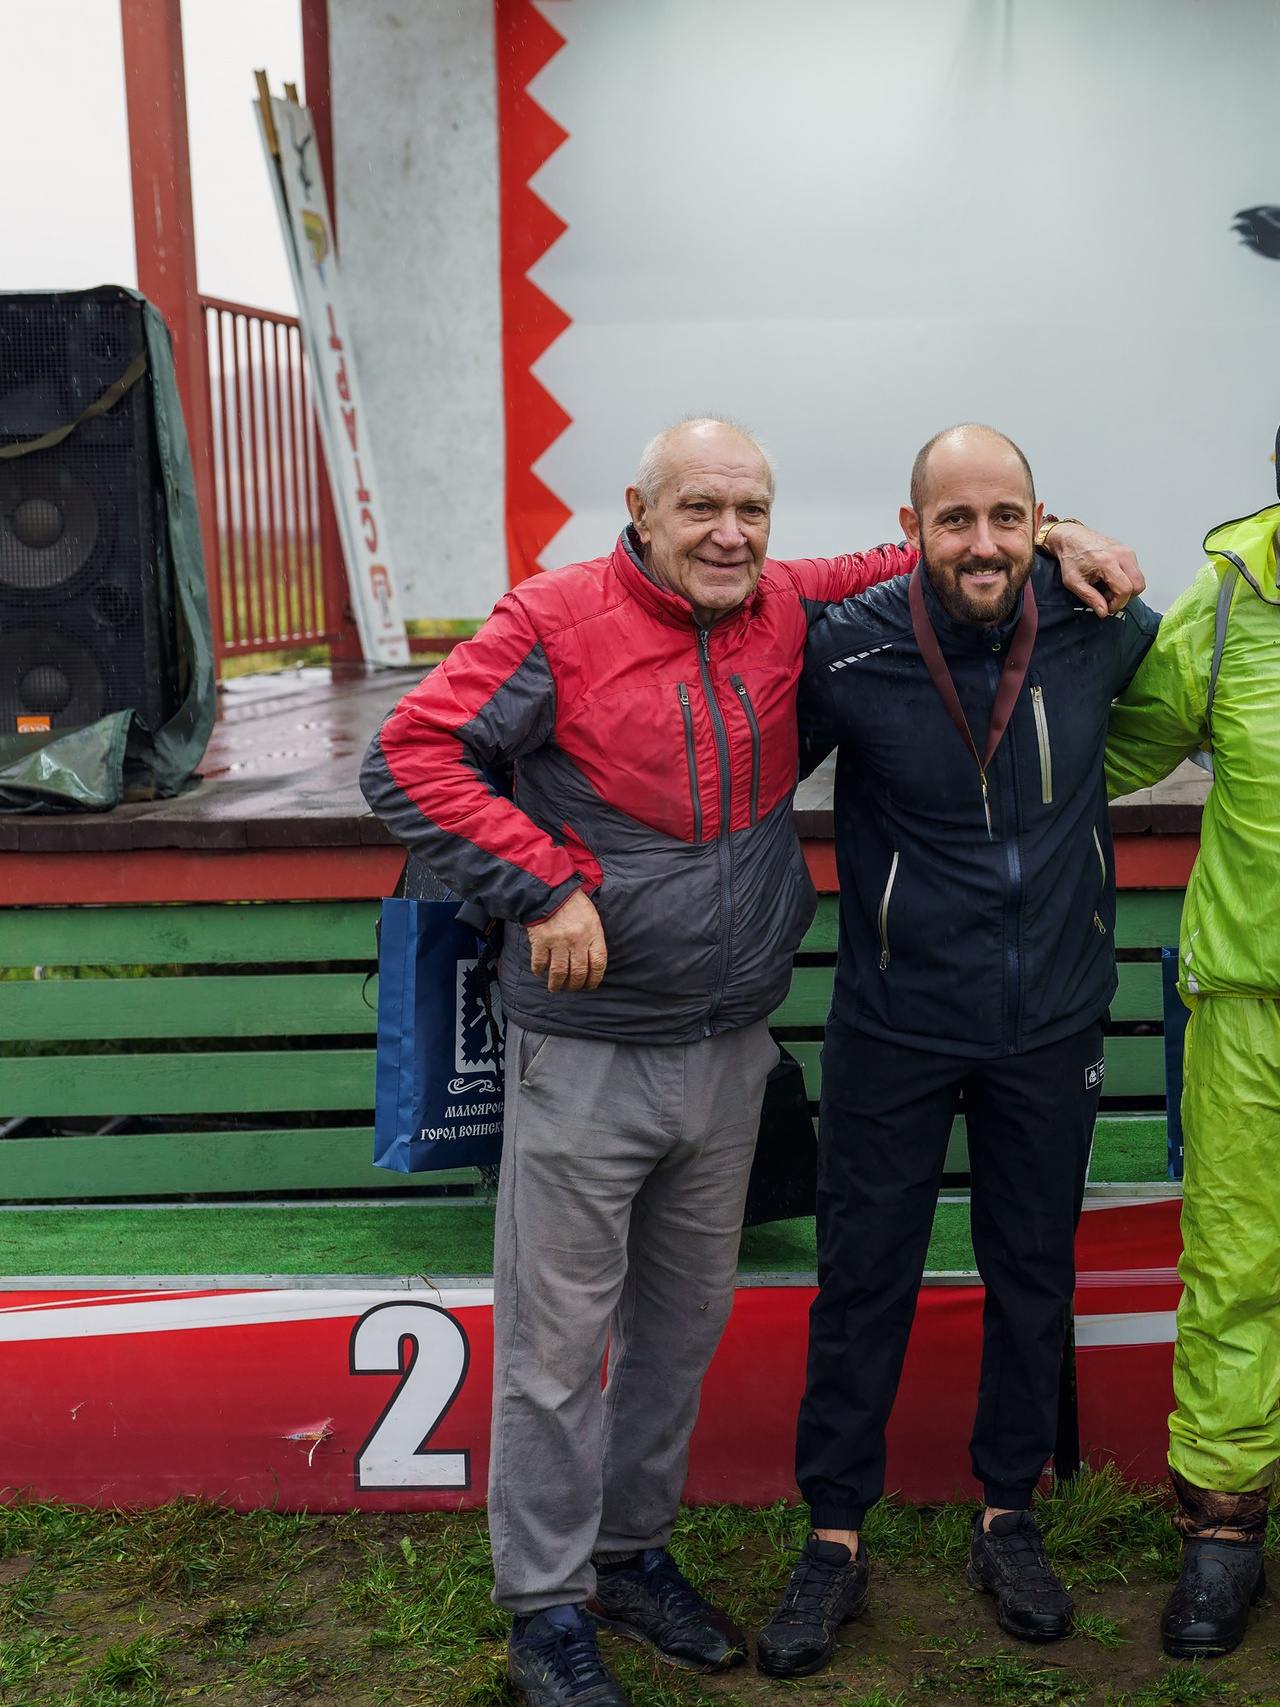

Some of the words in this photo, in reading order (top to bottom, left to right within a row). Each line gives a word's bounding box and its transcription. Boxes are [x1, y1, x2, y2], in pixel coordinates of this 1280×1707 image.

[444, 1101, 504, 1118] МАЛОЯРОС
[420, 1126, 457, 1140] ГОРОД
[349, 1300, 471, 1491] 2
